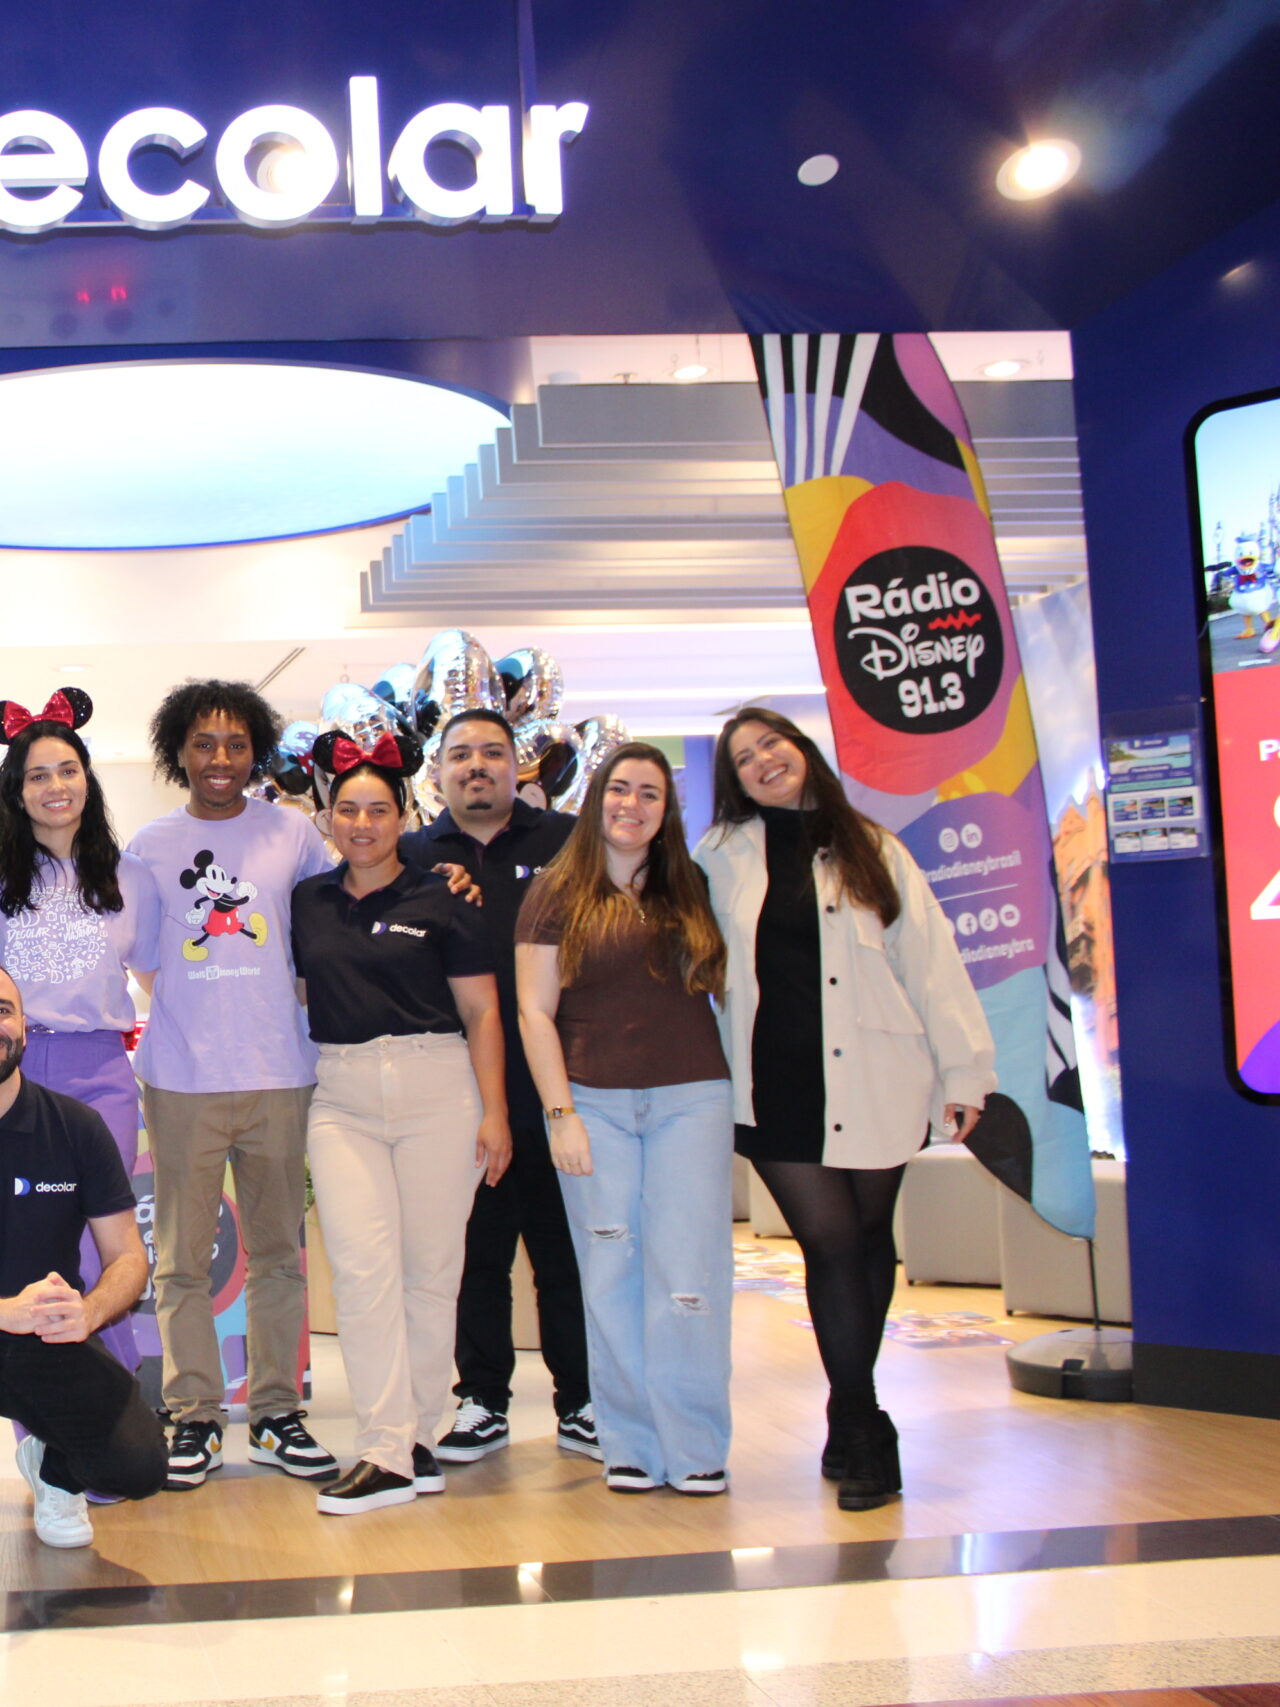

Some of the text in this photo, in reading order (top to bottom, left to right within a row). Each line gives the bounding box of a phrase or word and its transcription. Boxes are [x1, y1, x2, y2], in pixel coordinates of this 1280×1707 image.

[845, 572, 980, 623] Rádio
[898, 671, 965, 718] 91.3
[389, 923, 426, 937] decolar
[35, 1181, 77, 1192] decolar
